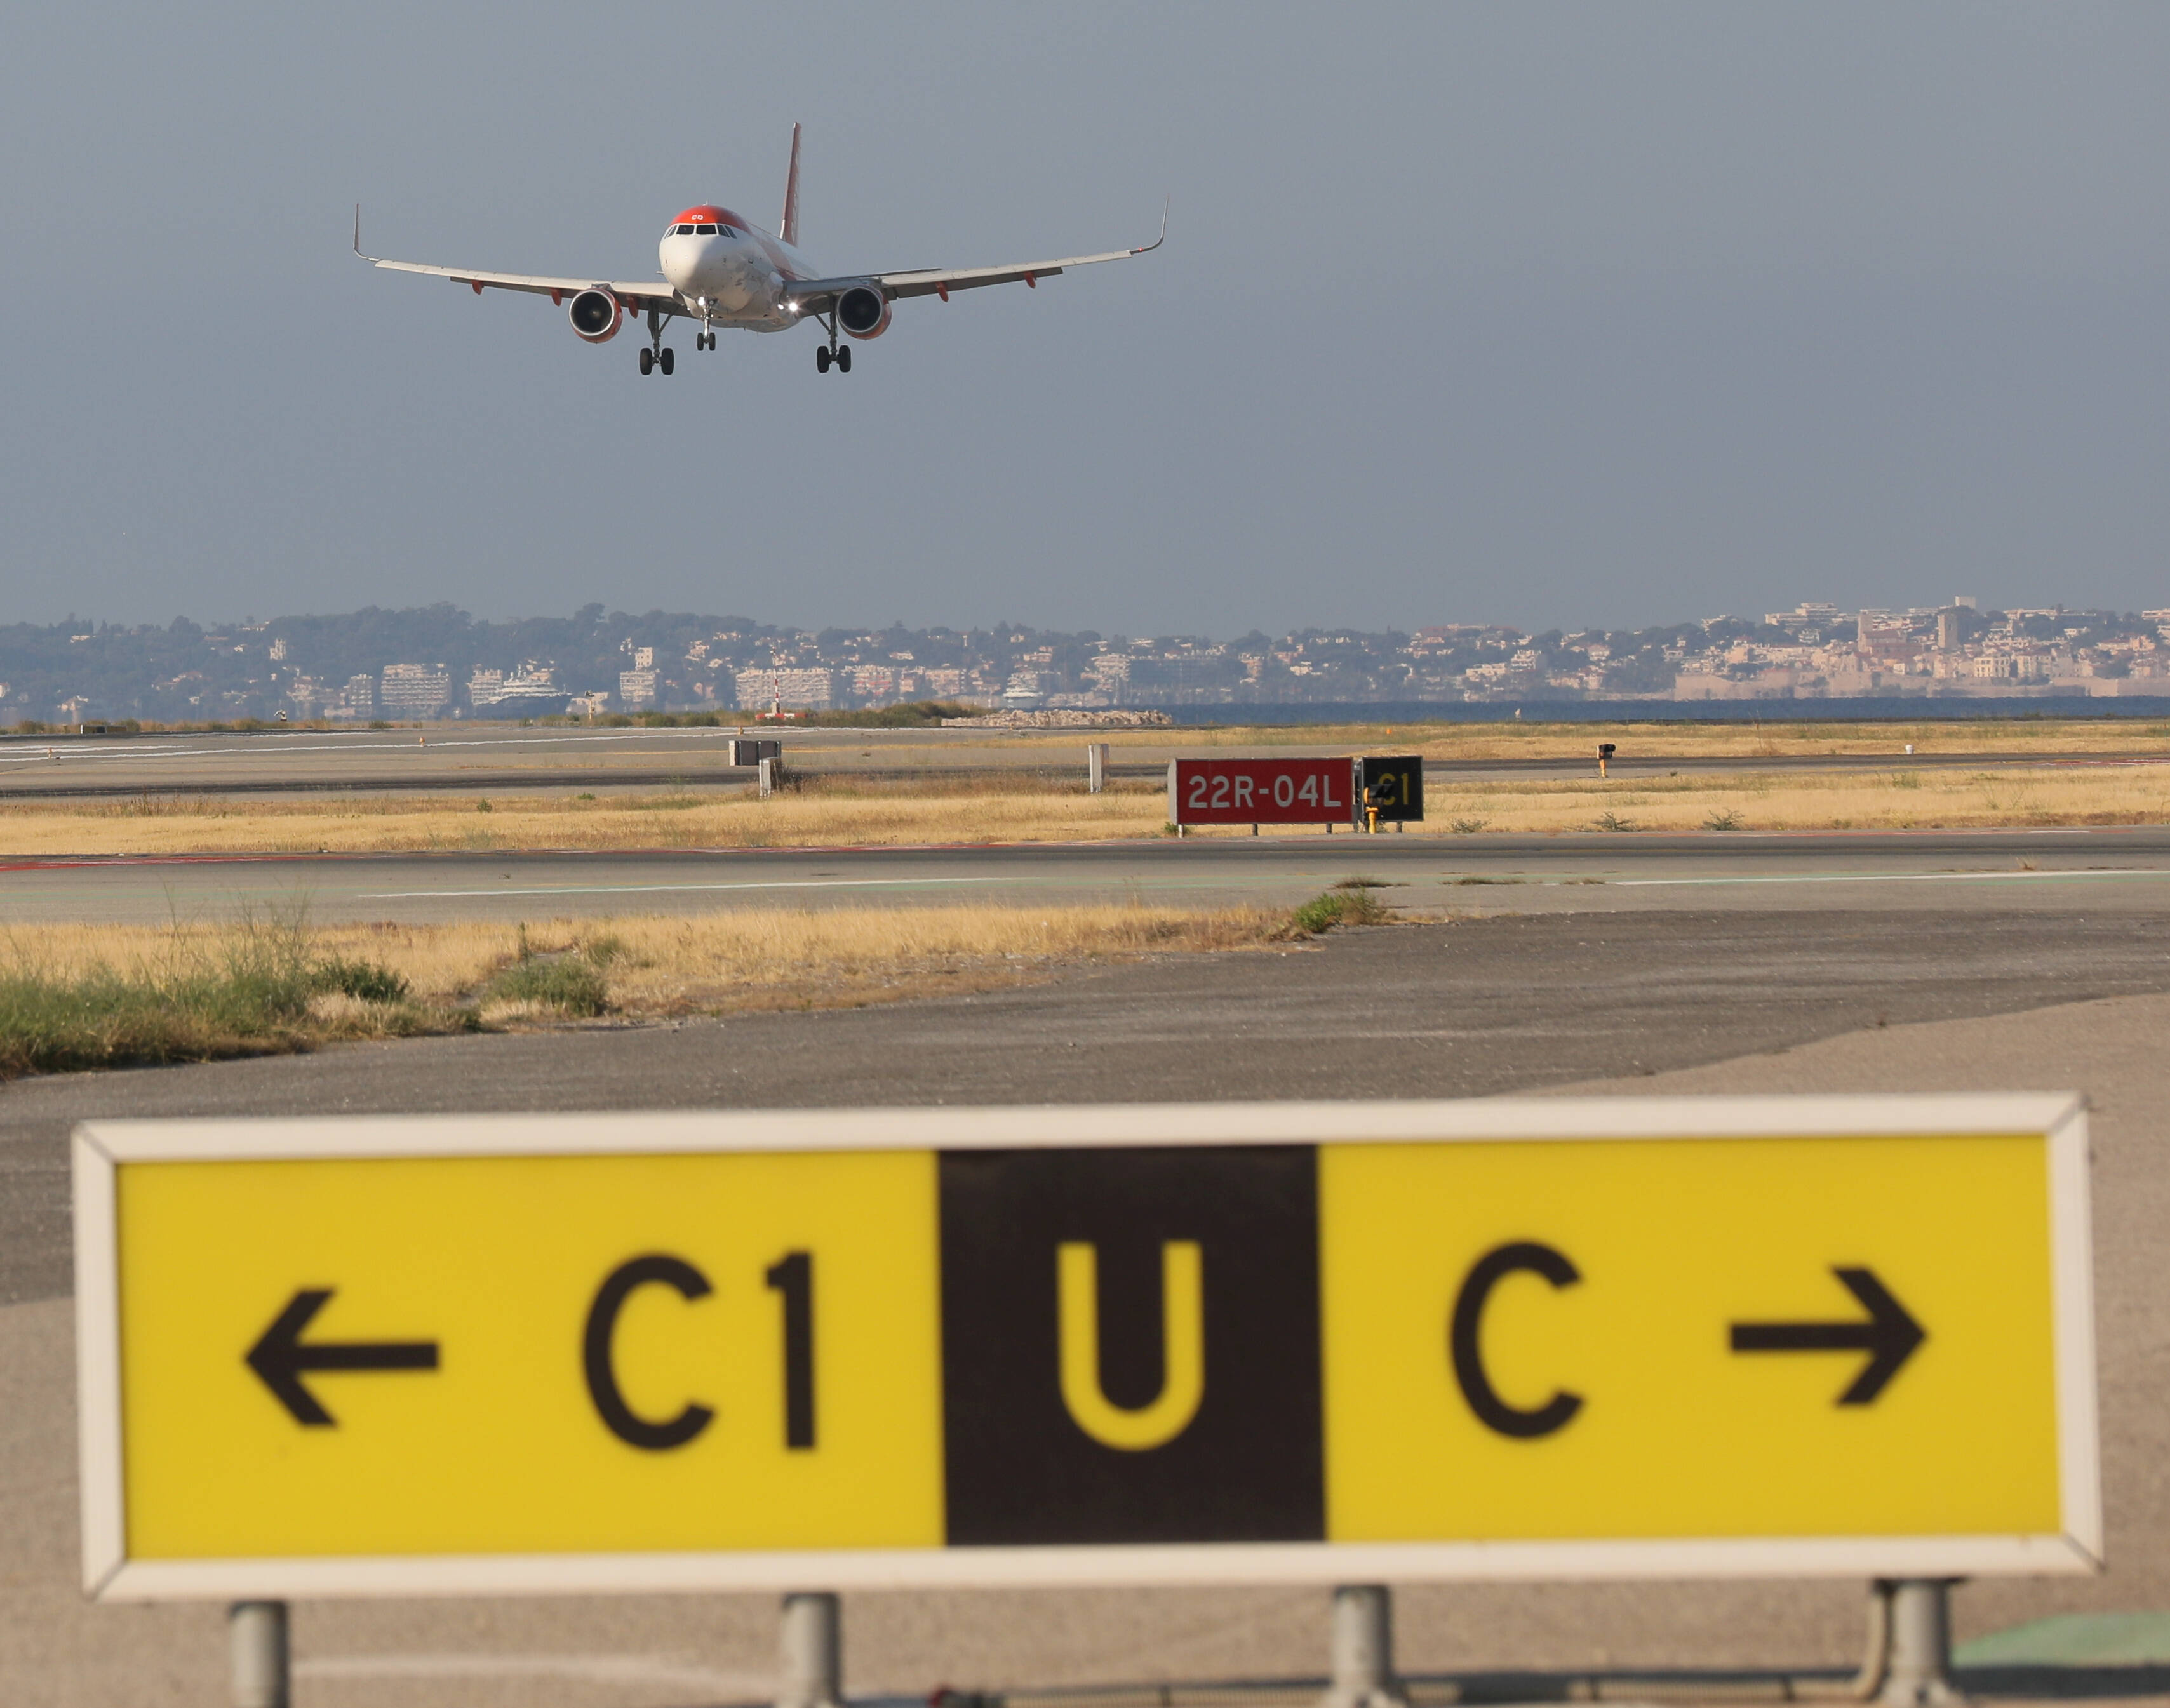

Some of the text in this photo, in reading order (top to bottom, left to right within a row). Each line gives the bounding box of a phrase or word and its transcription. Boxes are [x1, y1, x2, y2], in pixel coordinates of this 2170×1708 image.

[1189, 775, 1341, 808] 22R-04L
[582, 1240, 1584, 1452] C1 U C
